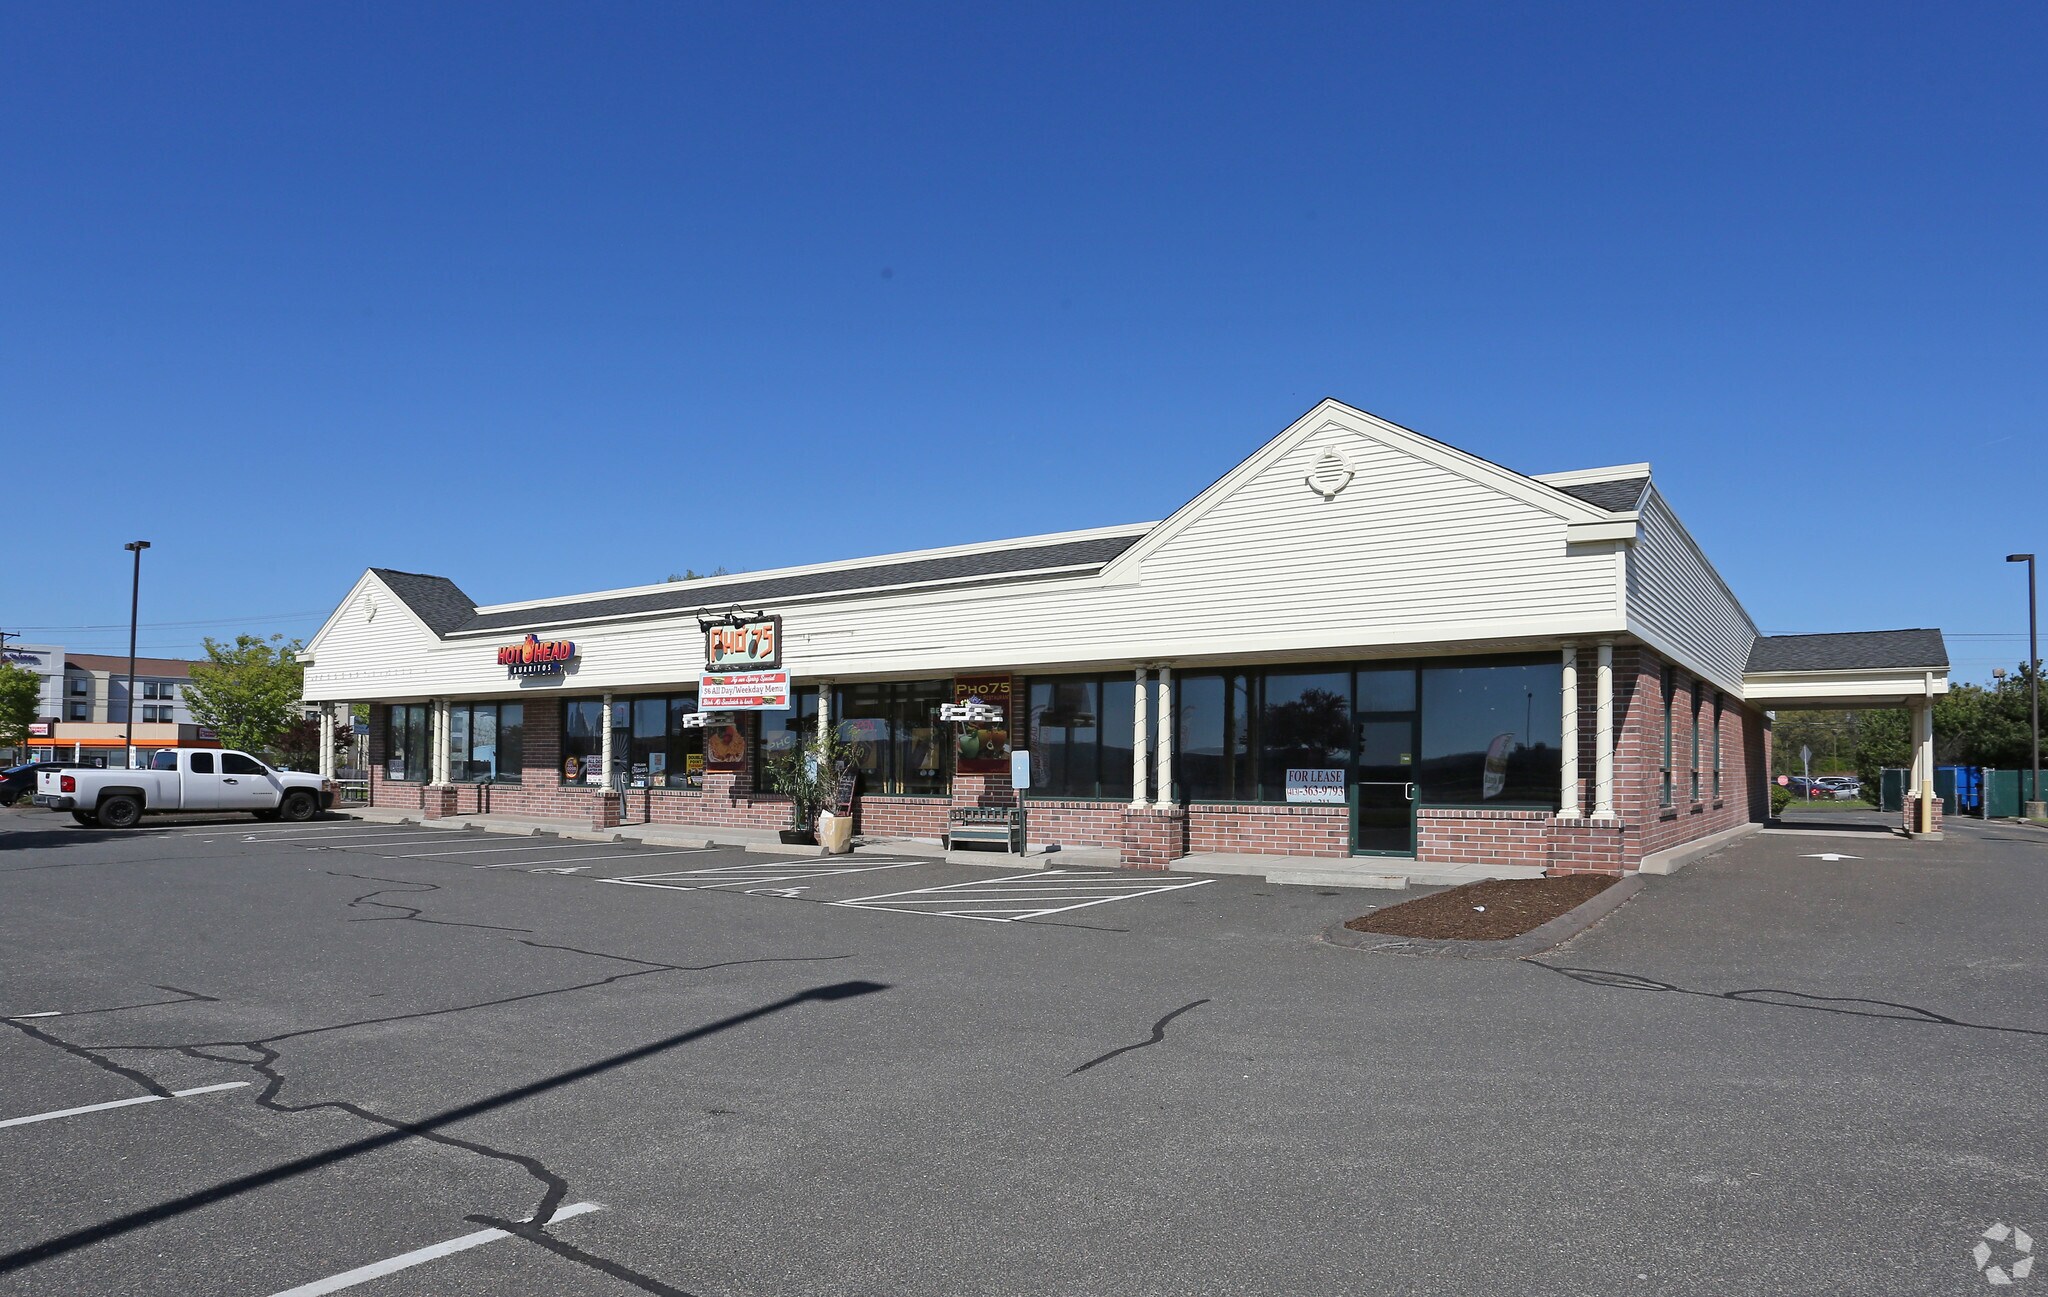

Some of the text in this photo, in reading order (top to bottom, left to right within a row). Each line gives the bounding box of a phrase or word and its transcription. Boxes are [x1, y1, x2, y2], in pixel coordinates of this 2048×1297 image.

[751, 625, 773, 659] 75
[497, 640, 573, 665] HOT HEAD
[513, 664, 551, 674] BURRITOS
[712, 686, 721, 695] All
[764, 684, 784, 693] Menu
[1289, 770, 1342, 782] FOR LEASE
